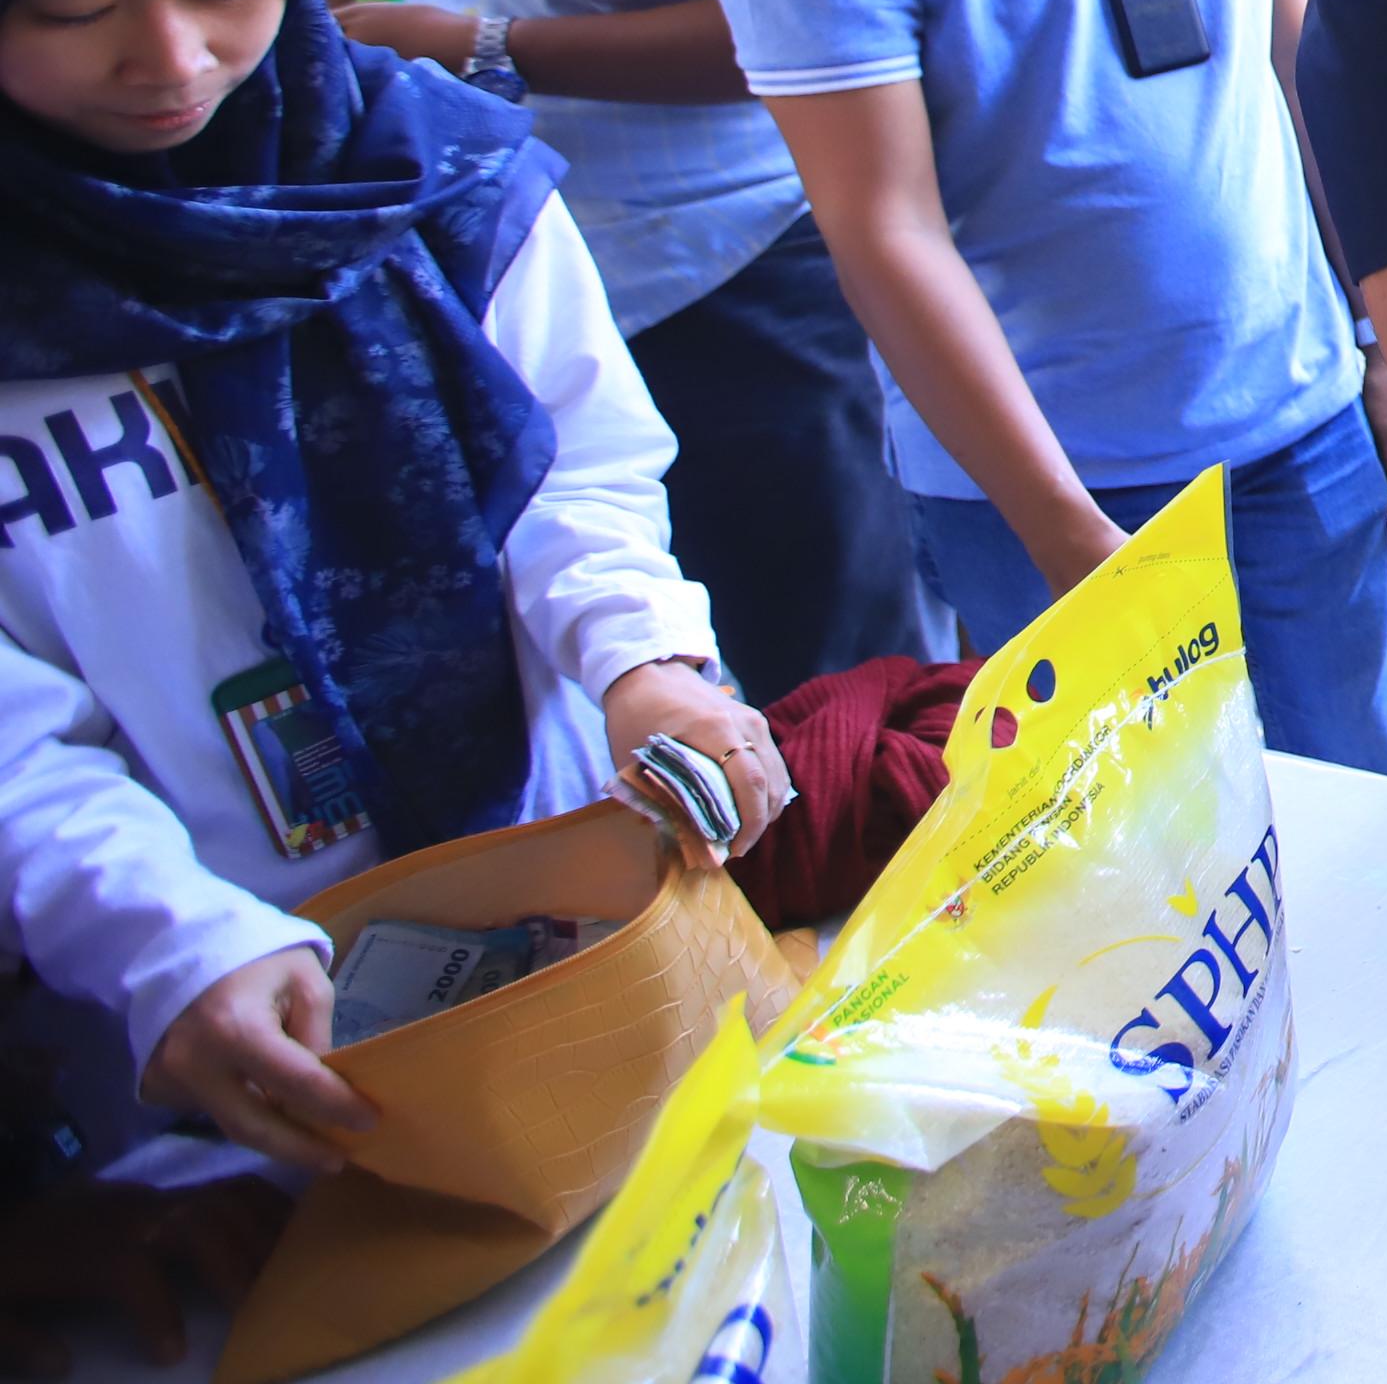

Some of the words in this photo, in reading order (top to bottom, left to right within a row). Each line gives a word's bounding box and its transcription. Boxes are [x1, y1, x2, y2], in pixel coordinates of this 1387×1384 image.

[974, 794, 1059, 871] KEMENTERIAN
[981, 836, 1031, 884] BIDANG
[427, 947, 471, 1004] 2000
